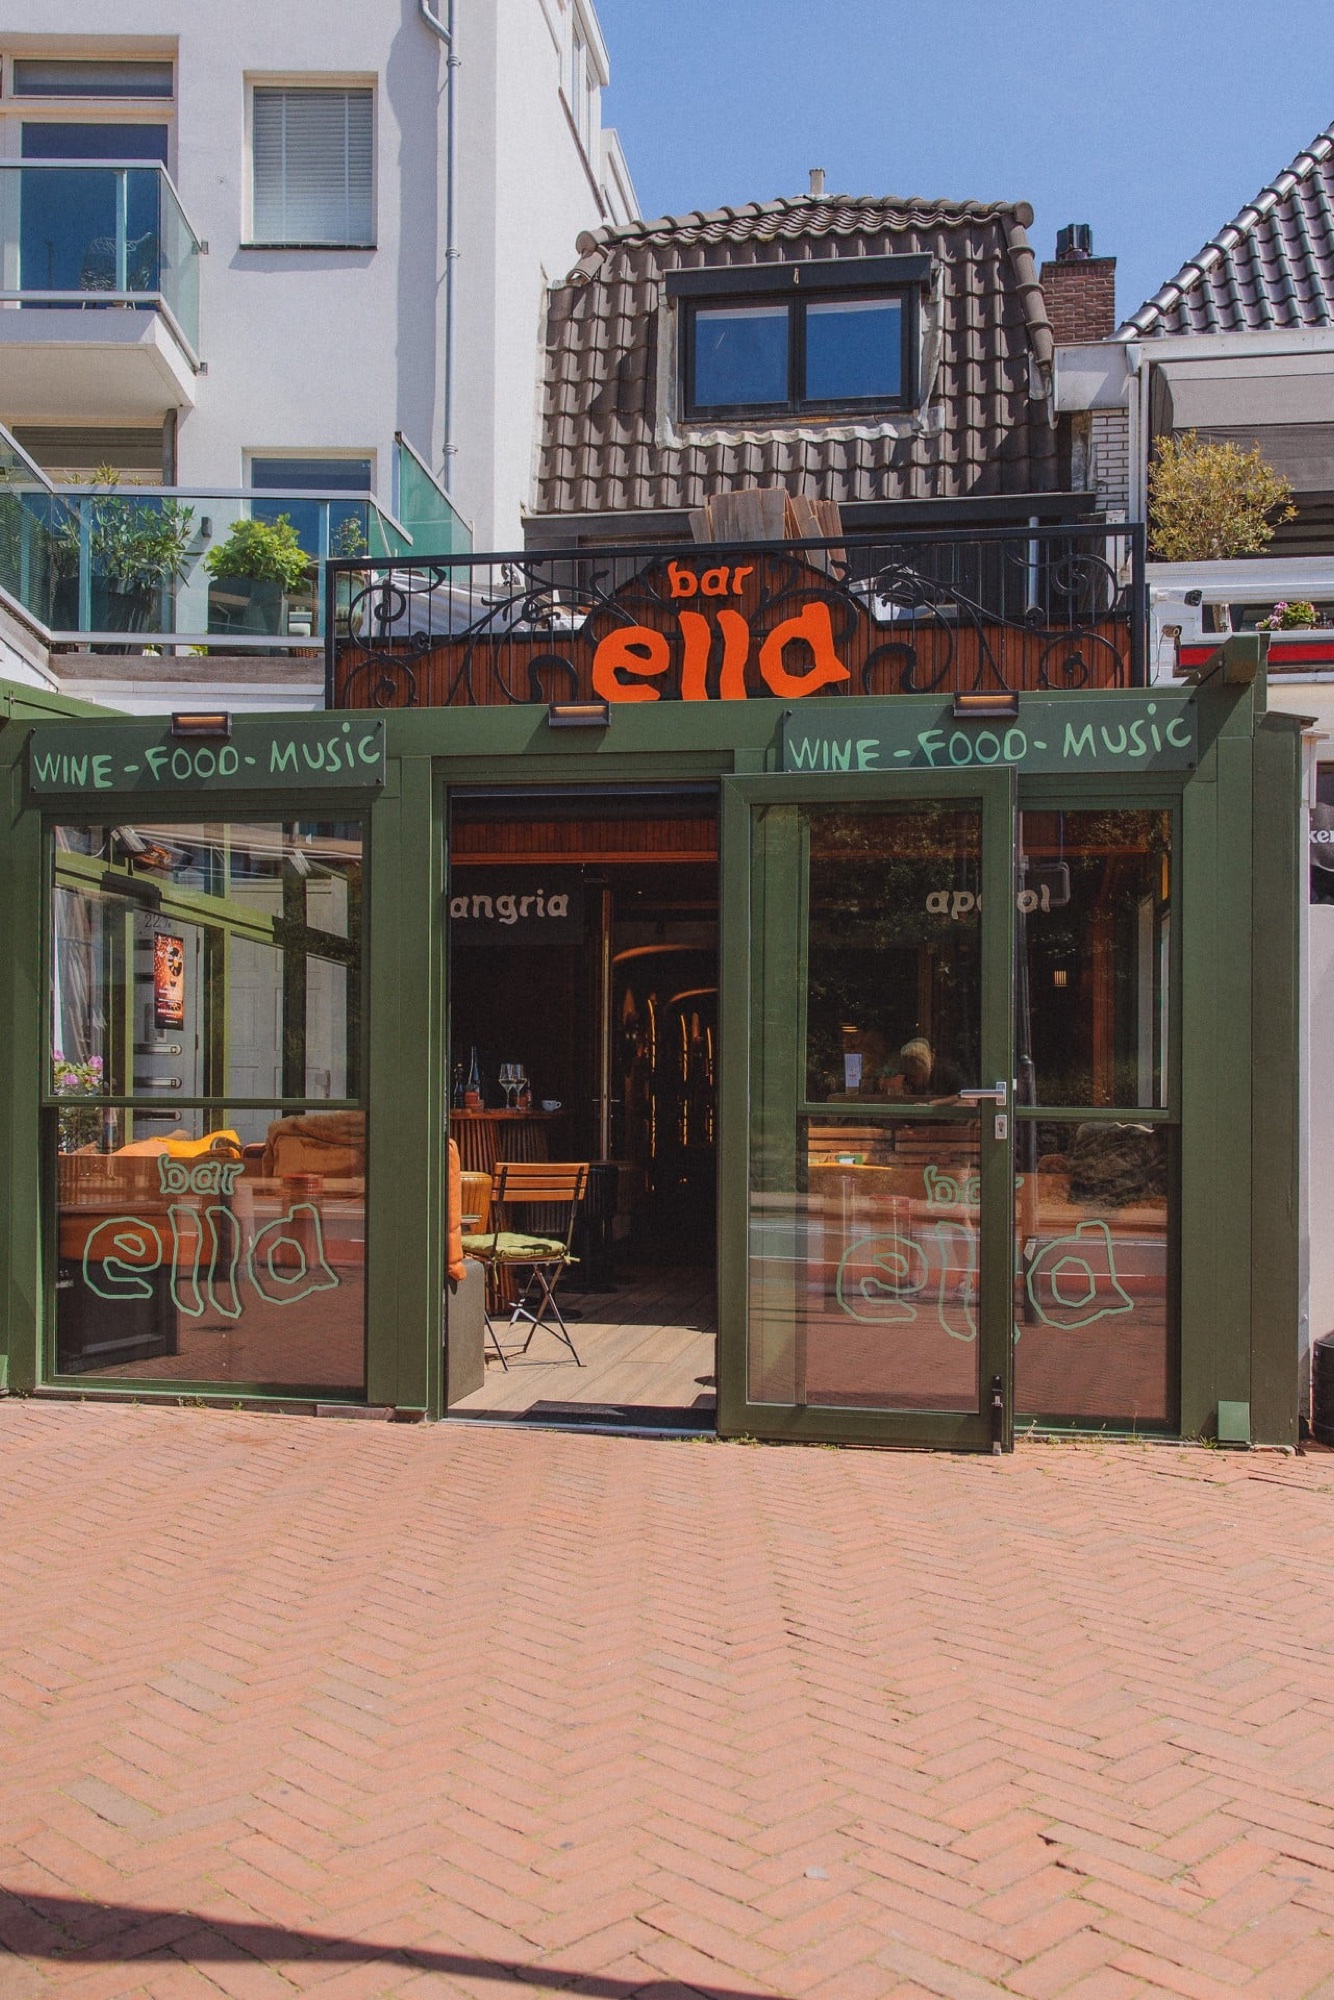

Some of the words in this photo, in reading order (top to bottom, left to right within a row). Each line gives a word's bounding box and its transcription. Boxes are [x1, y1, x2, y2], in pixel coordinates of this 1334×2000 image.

[667, 561, 753, 598] bar
[592, 601, 851, 702] ella
[34, 754, 113, 789] WINE
[145, 746, 239, 781] FOOD
[788, 738, 880, 770] WINE
[917, 728, 1028, 766] FOOD
[925, 884, 1051, 920] apol
[157, 1153, 246, 1196] bar
[923, 1165, 1025, 1210] ba
[82, 1202, 340, 1319] ella
[835, 1219, 1135, 1343] ela
